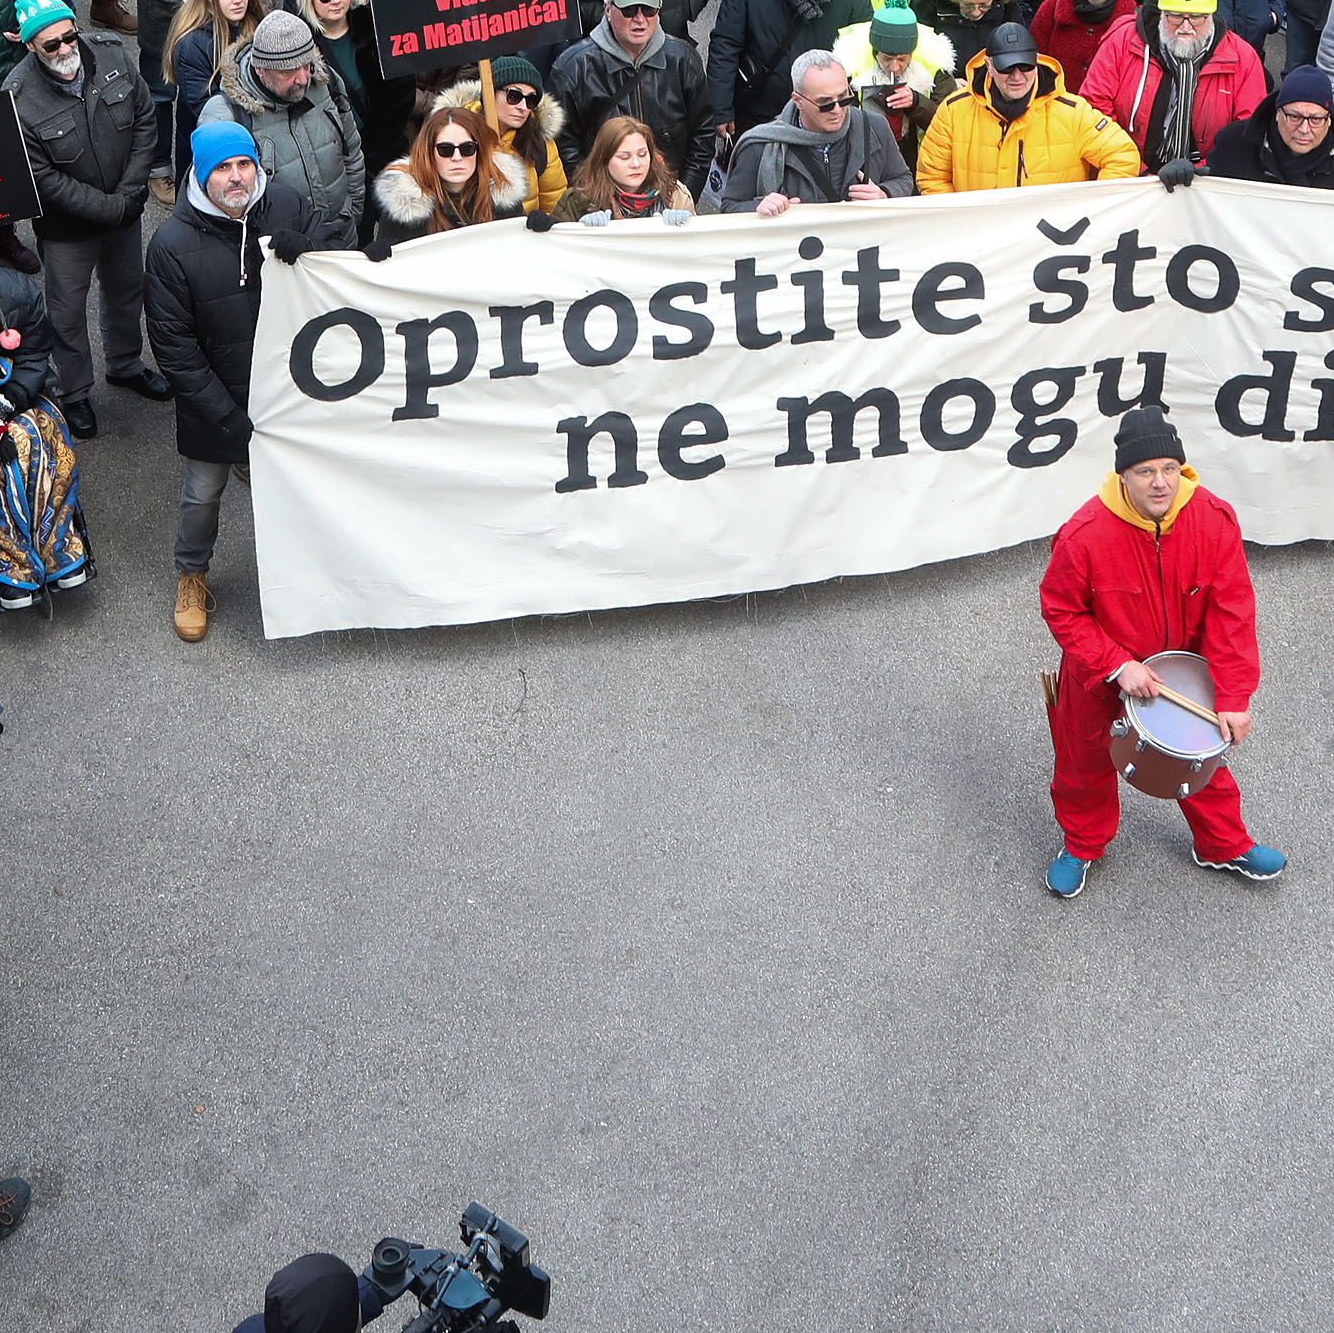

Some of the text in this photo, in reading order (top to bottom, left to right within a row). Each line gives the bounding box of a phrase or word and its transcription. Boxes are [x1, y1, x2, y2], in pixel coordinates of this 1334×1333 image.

[389, 30, 419, 57] za
[287, 235, 986, 423] Oprostite
[1027, 216, 1242, 325] što
[553, 401, 730, 495] ne
[773, 350, 1171, 470] mogu
